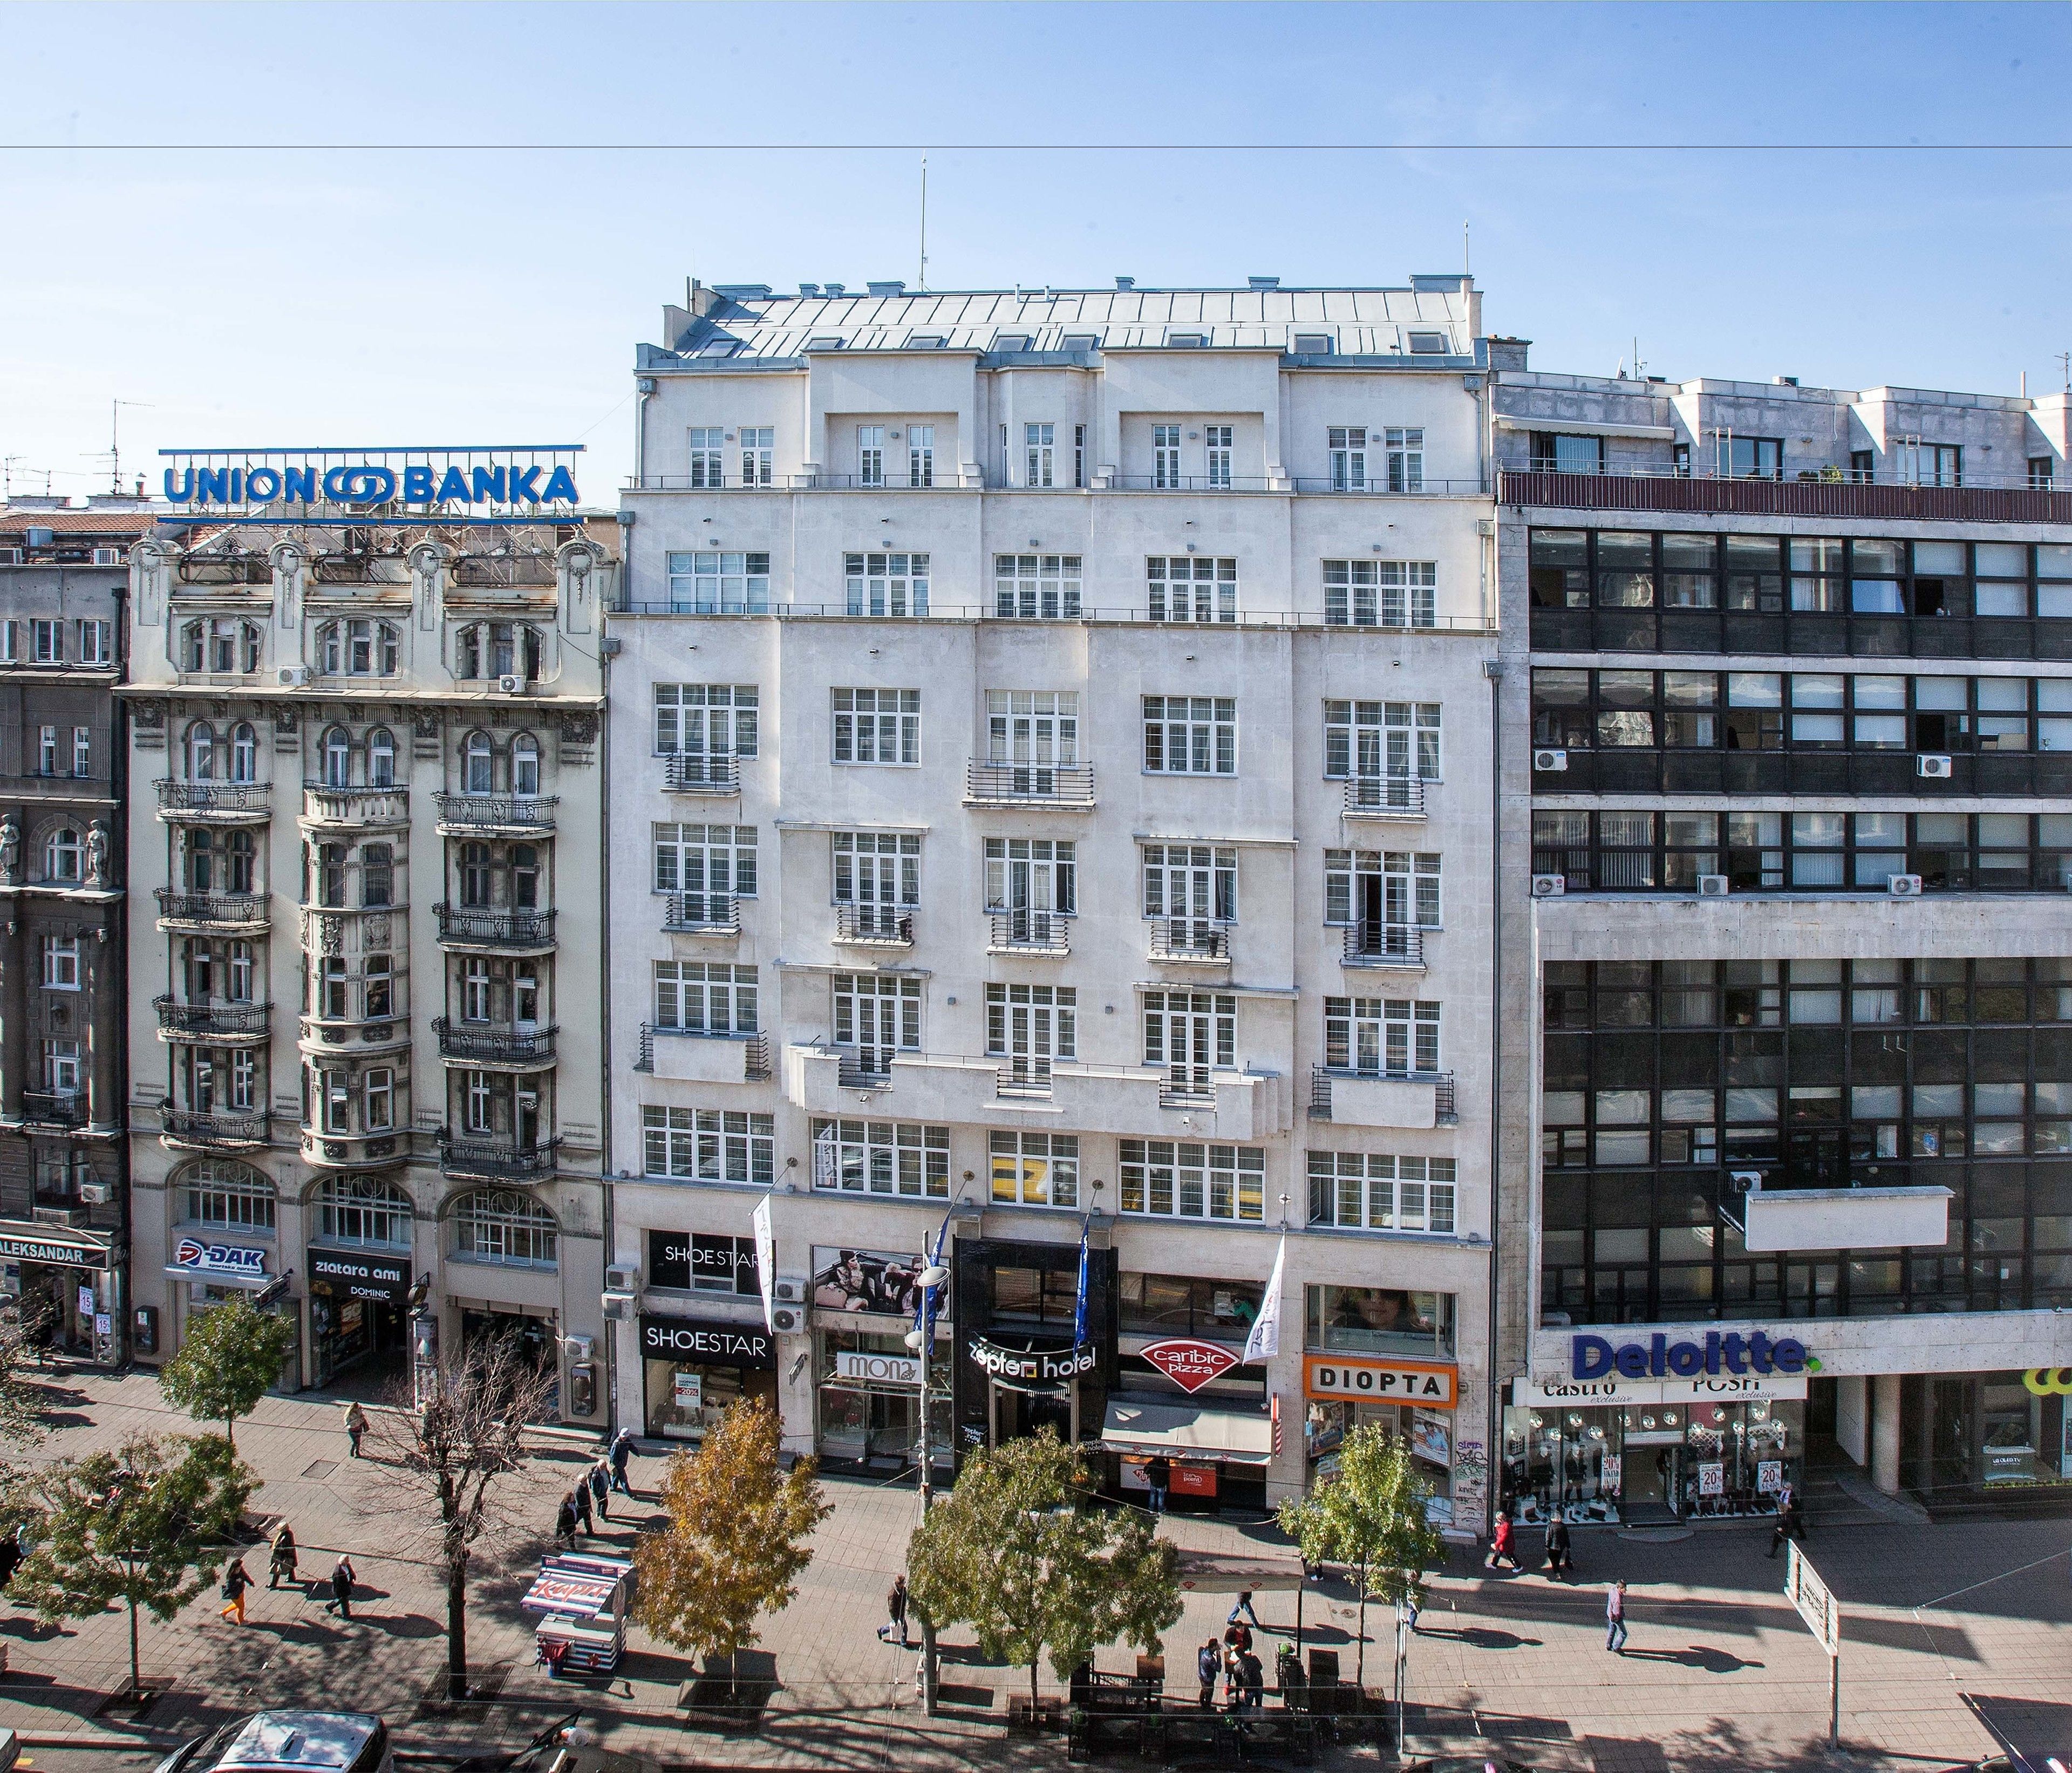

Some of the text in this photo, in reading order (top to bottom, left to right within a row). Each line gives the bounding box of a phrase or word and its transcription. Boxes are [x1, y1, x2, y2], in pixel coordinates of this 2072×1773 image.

[164, 466, 581, 504] UNION BANKA
[665, 1246, 759, 1269] SHOESTAR
[316, 1260, 400, 1281] zlatara ami
[351, 1286, 390, 1298] DOMINIC
[647, 1327, 766, 1357] SHOESTAR
[1043, 1346, 1096, 1378] hotel
[1153, 1349, 1225, 1365] caribic
[1168, 1363, 1214, 1375] pizza
[678, 1388, 698, 1396] -20%
[1320, 1367, 1441, 1395] DIOPTA
[531, 1579, 609, 1602] Kapri
